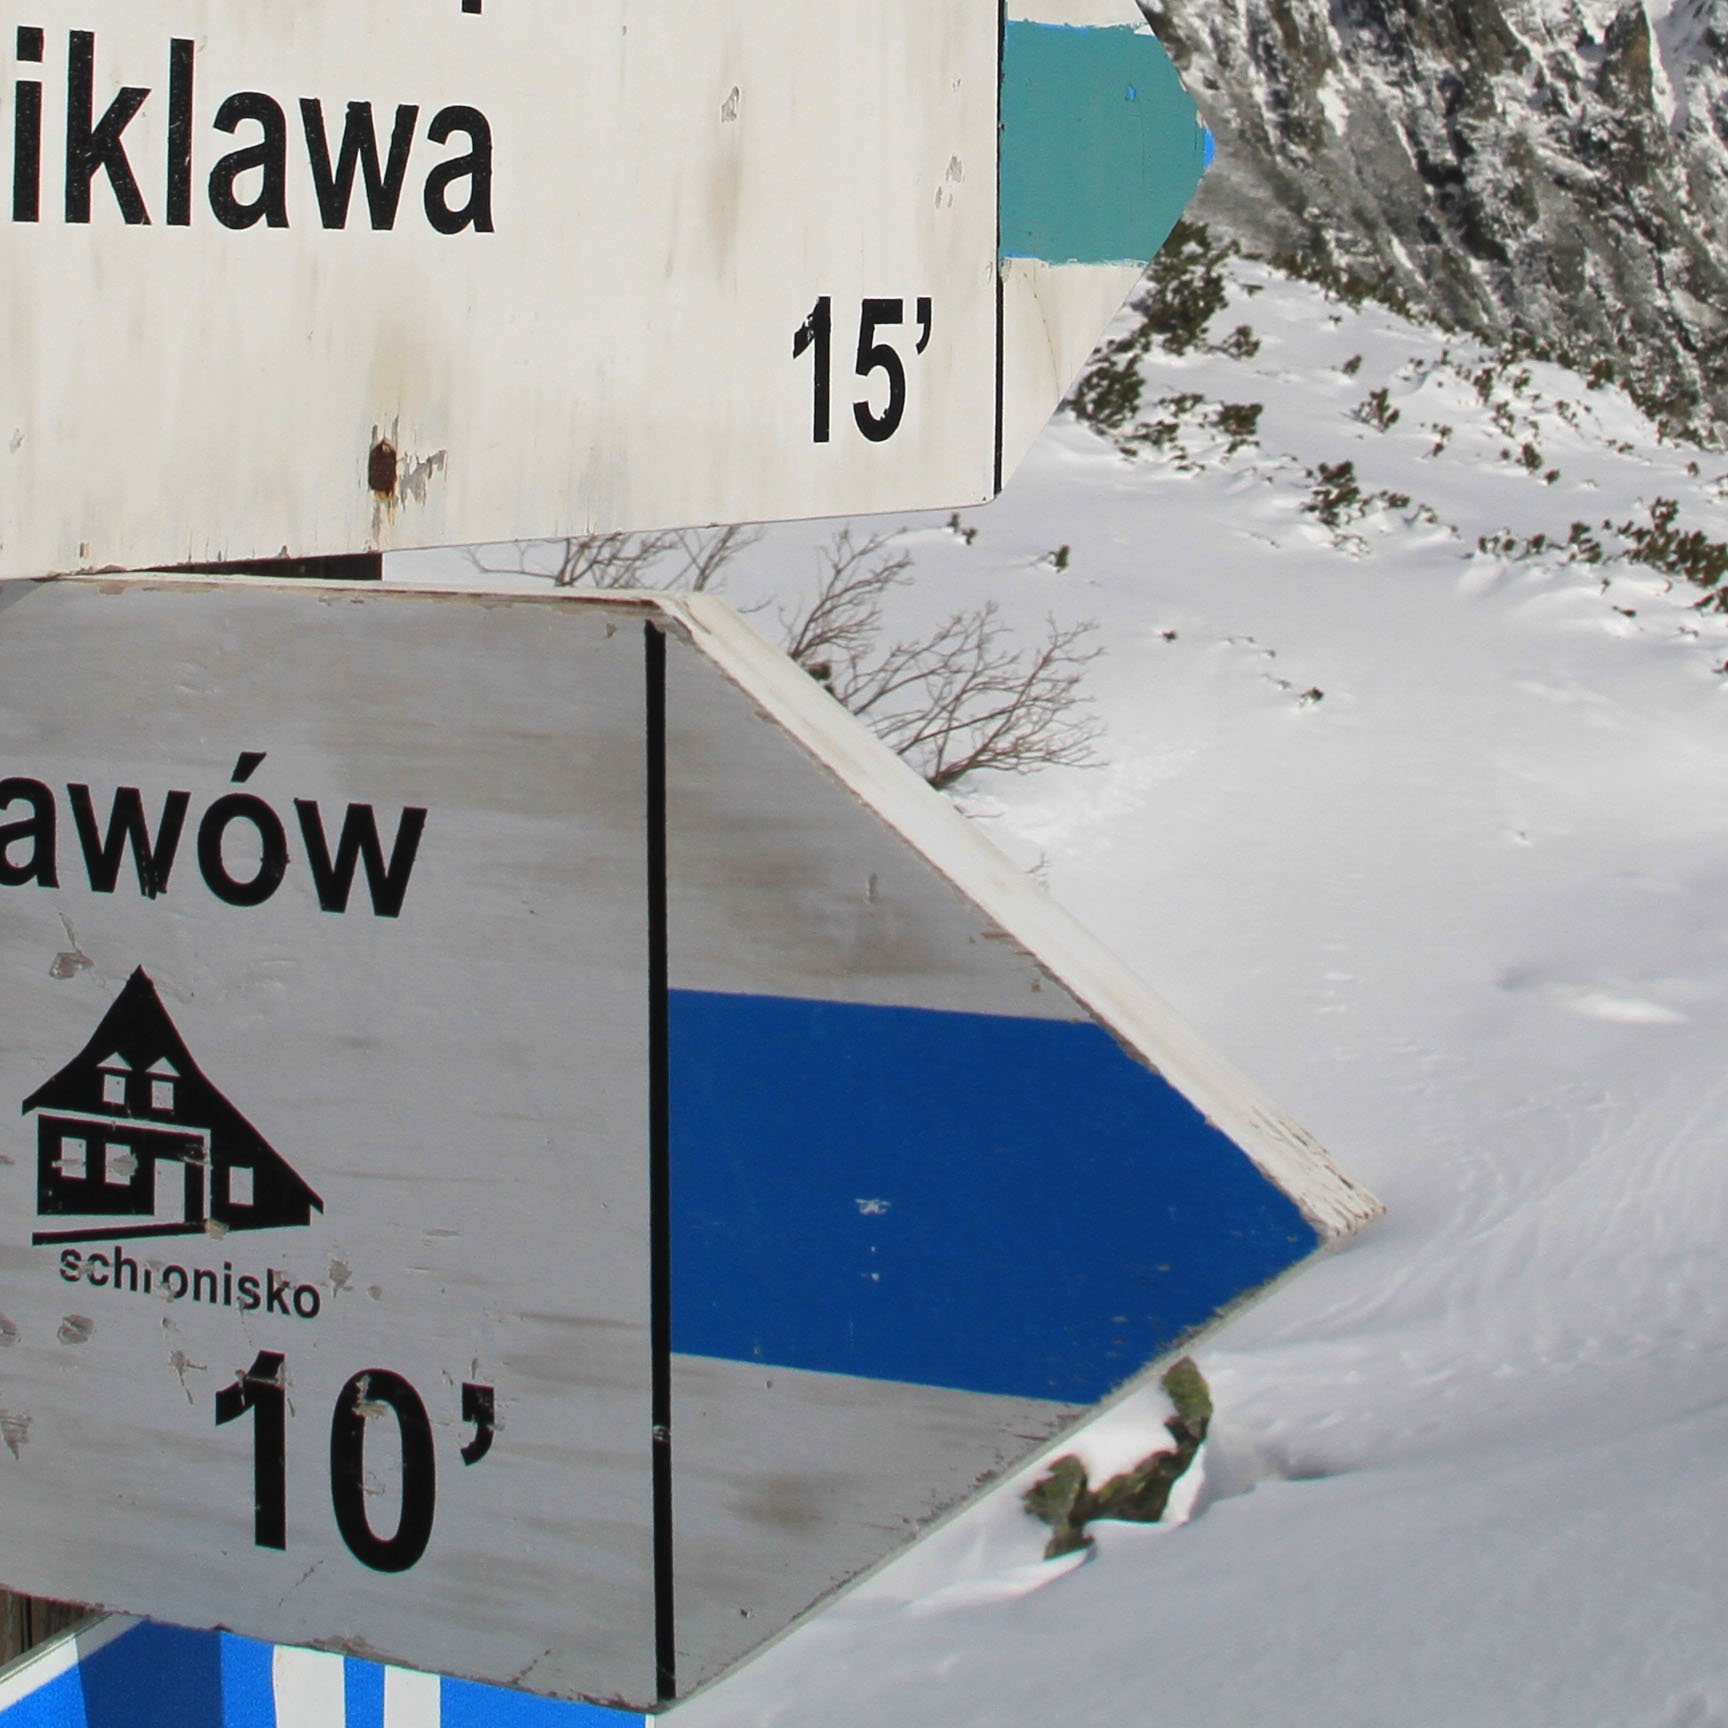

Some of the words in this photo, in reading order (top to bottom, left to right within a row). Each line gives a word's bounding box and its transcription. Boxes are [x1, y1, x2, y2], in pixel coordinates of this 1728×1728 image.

[793, 297, 931, 442] 15’
[61, 1247, 319, 1318] schronisko
[216, 1351, 494, 1572] 10’
